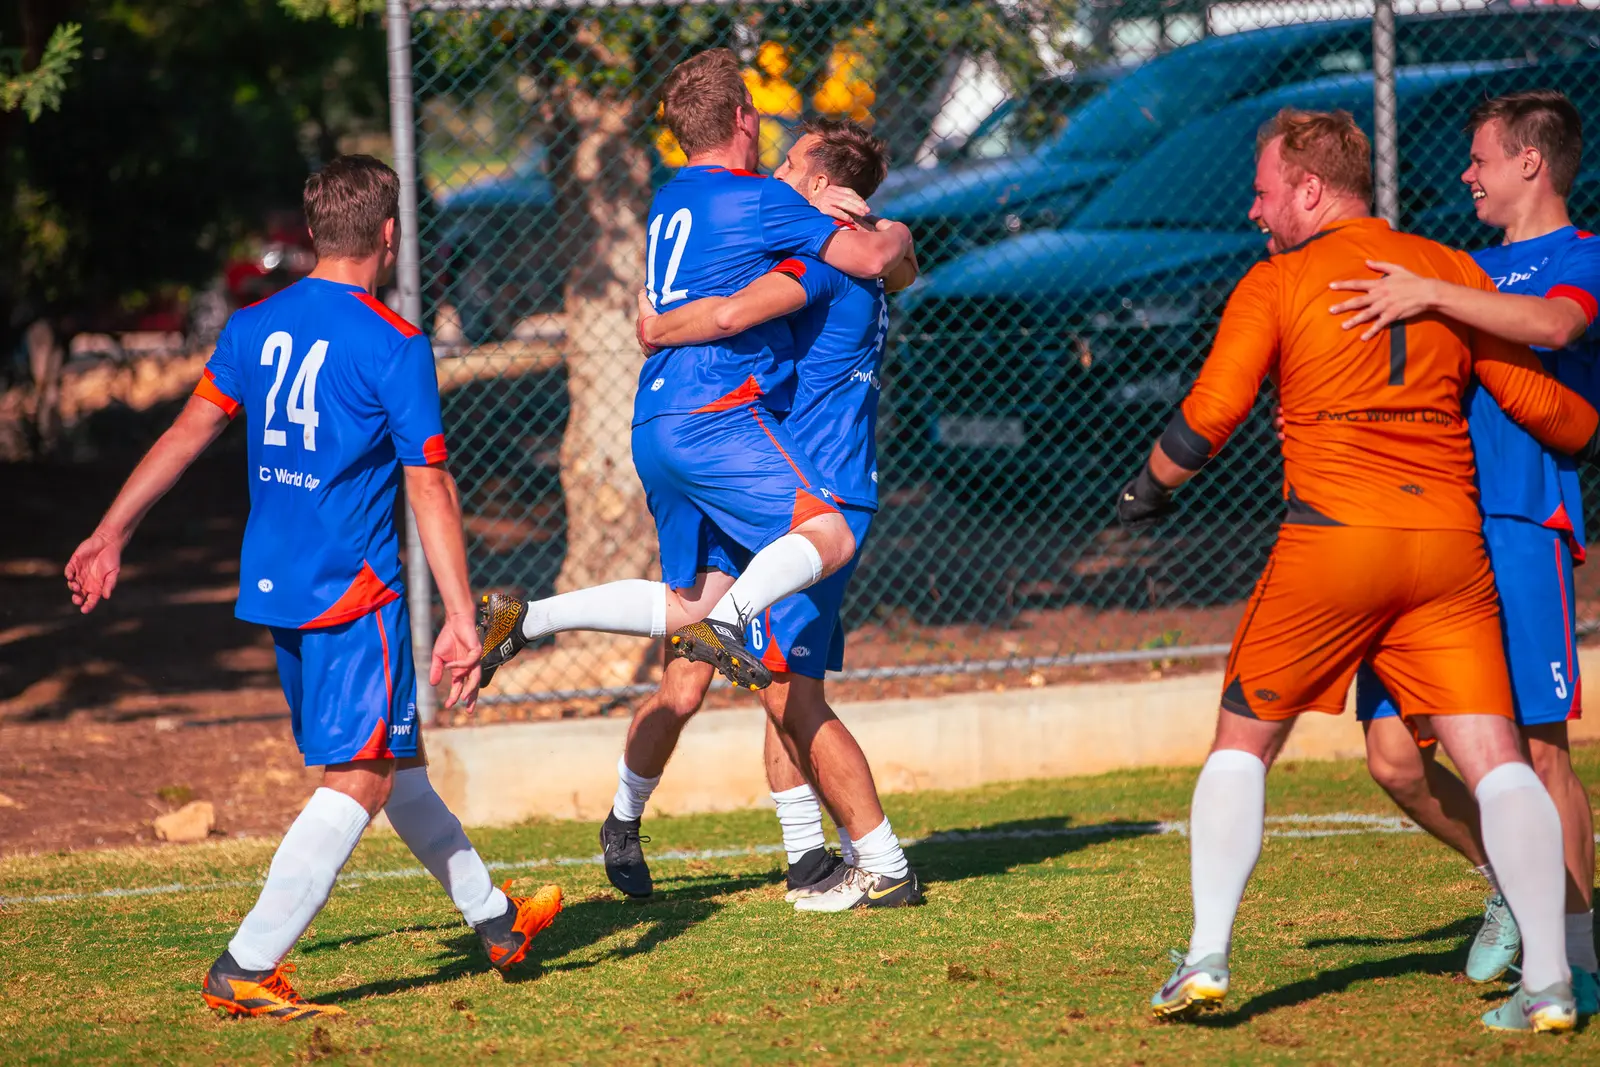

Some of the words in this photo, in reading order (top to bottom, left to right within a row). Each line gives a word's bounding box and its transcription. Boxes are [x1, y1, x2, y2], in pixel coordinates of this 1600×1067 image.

[646, 207, 692, 309] 12
[260, 330, 330, 452] 24
[1365, 410, 1416, 423] World
[1421, 409, 1453, 428] Cup
[274, 467, 304, 488] World
[304, 473, 321, 492] Cup
[751, 617, 764, 651] 6
[1550, 661, 1568, 700] 5
